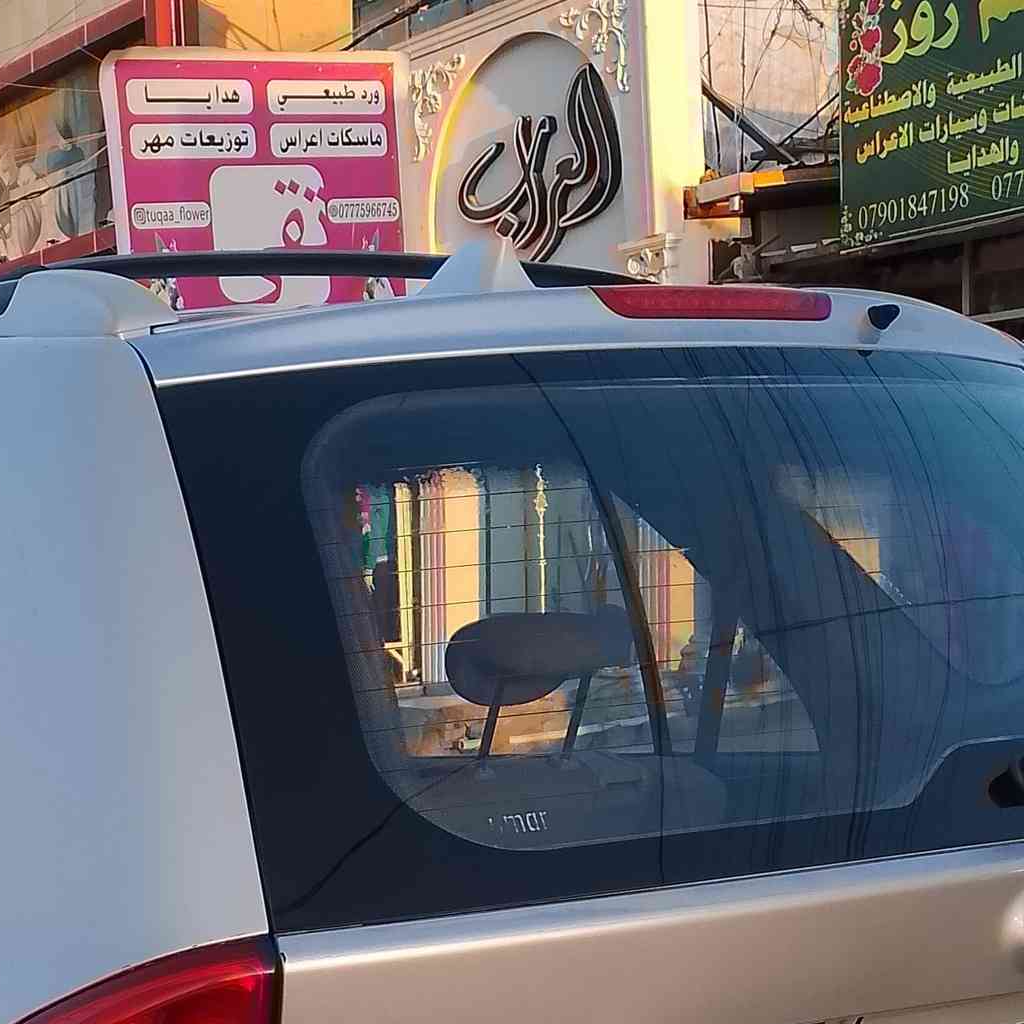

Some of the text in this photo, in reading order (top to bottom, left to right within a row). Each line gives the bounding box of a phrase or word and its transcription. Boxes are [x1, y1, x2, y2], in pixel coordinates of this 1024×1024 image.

[946, 52, 1022, 99] الطبيعية
[144, 83, 240, 111] هدايا
[277, 85, 380, 111] ورد طبيعي
[141, 129, 249, 153] توزيعات مهر
[279, 127, 382, 153] ماسكات اعراس
[918, 108, 987, 143] وسيارات
[946, 135, 1020, 176] والهدايا
[858, 182, 970, 230] 07901847198
